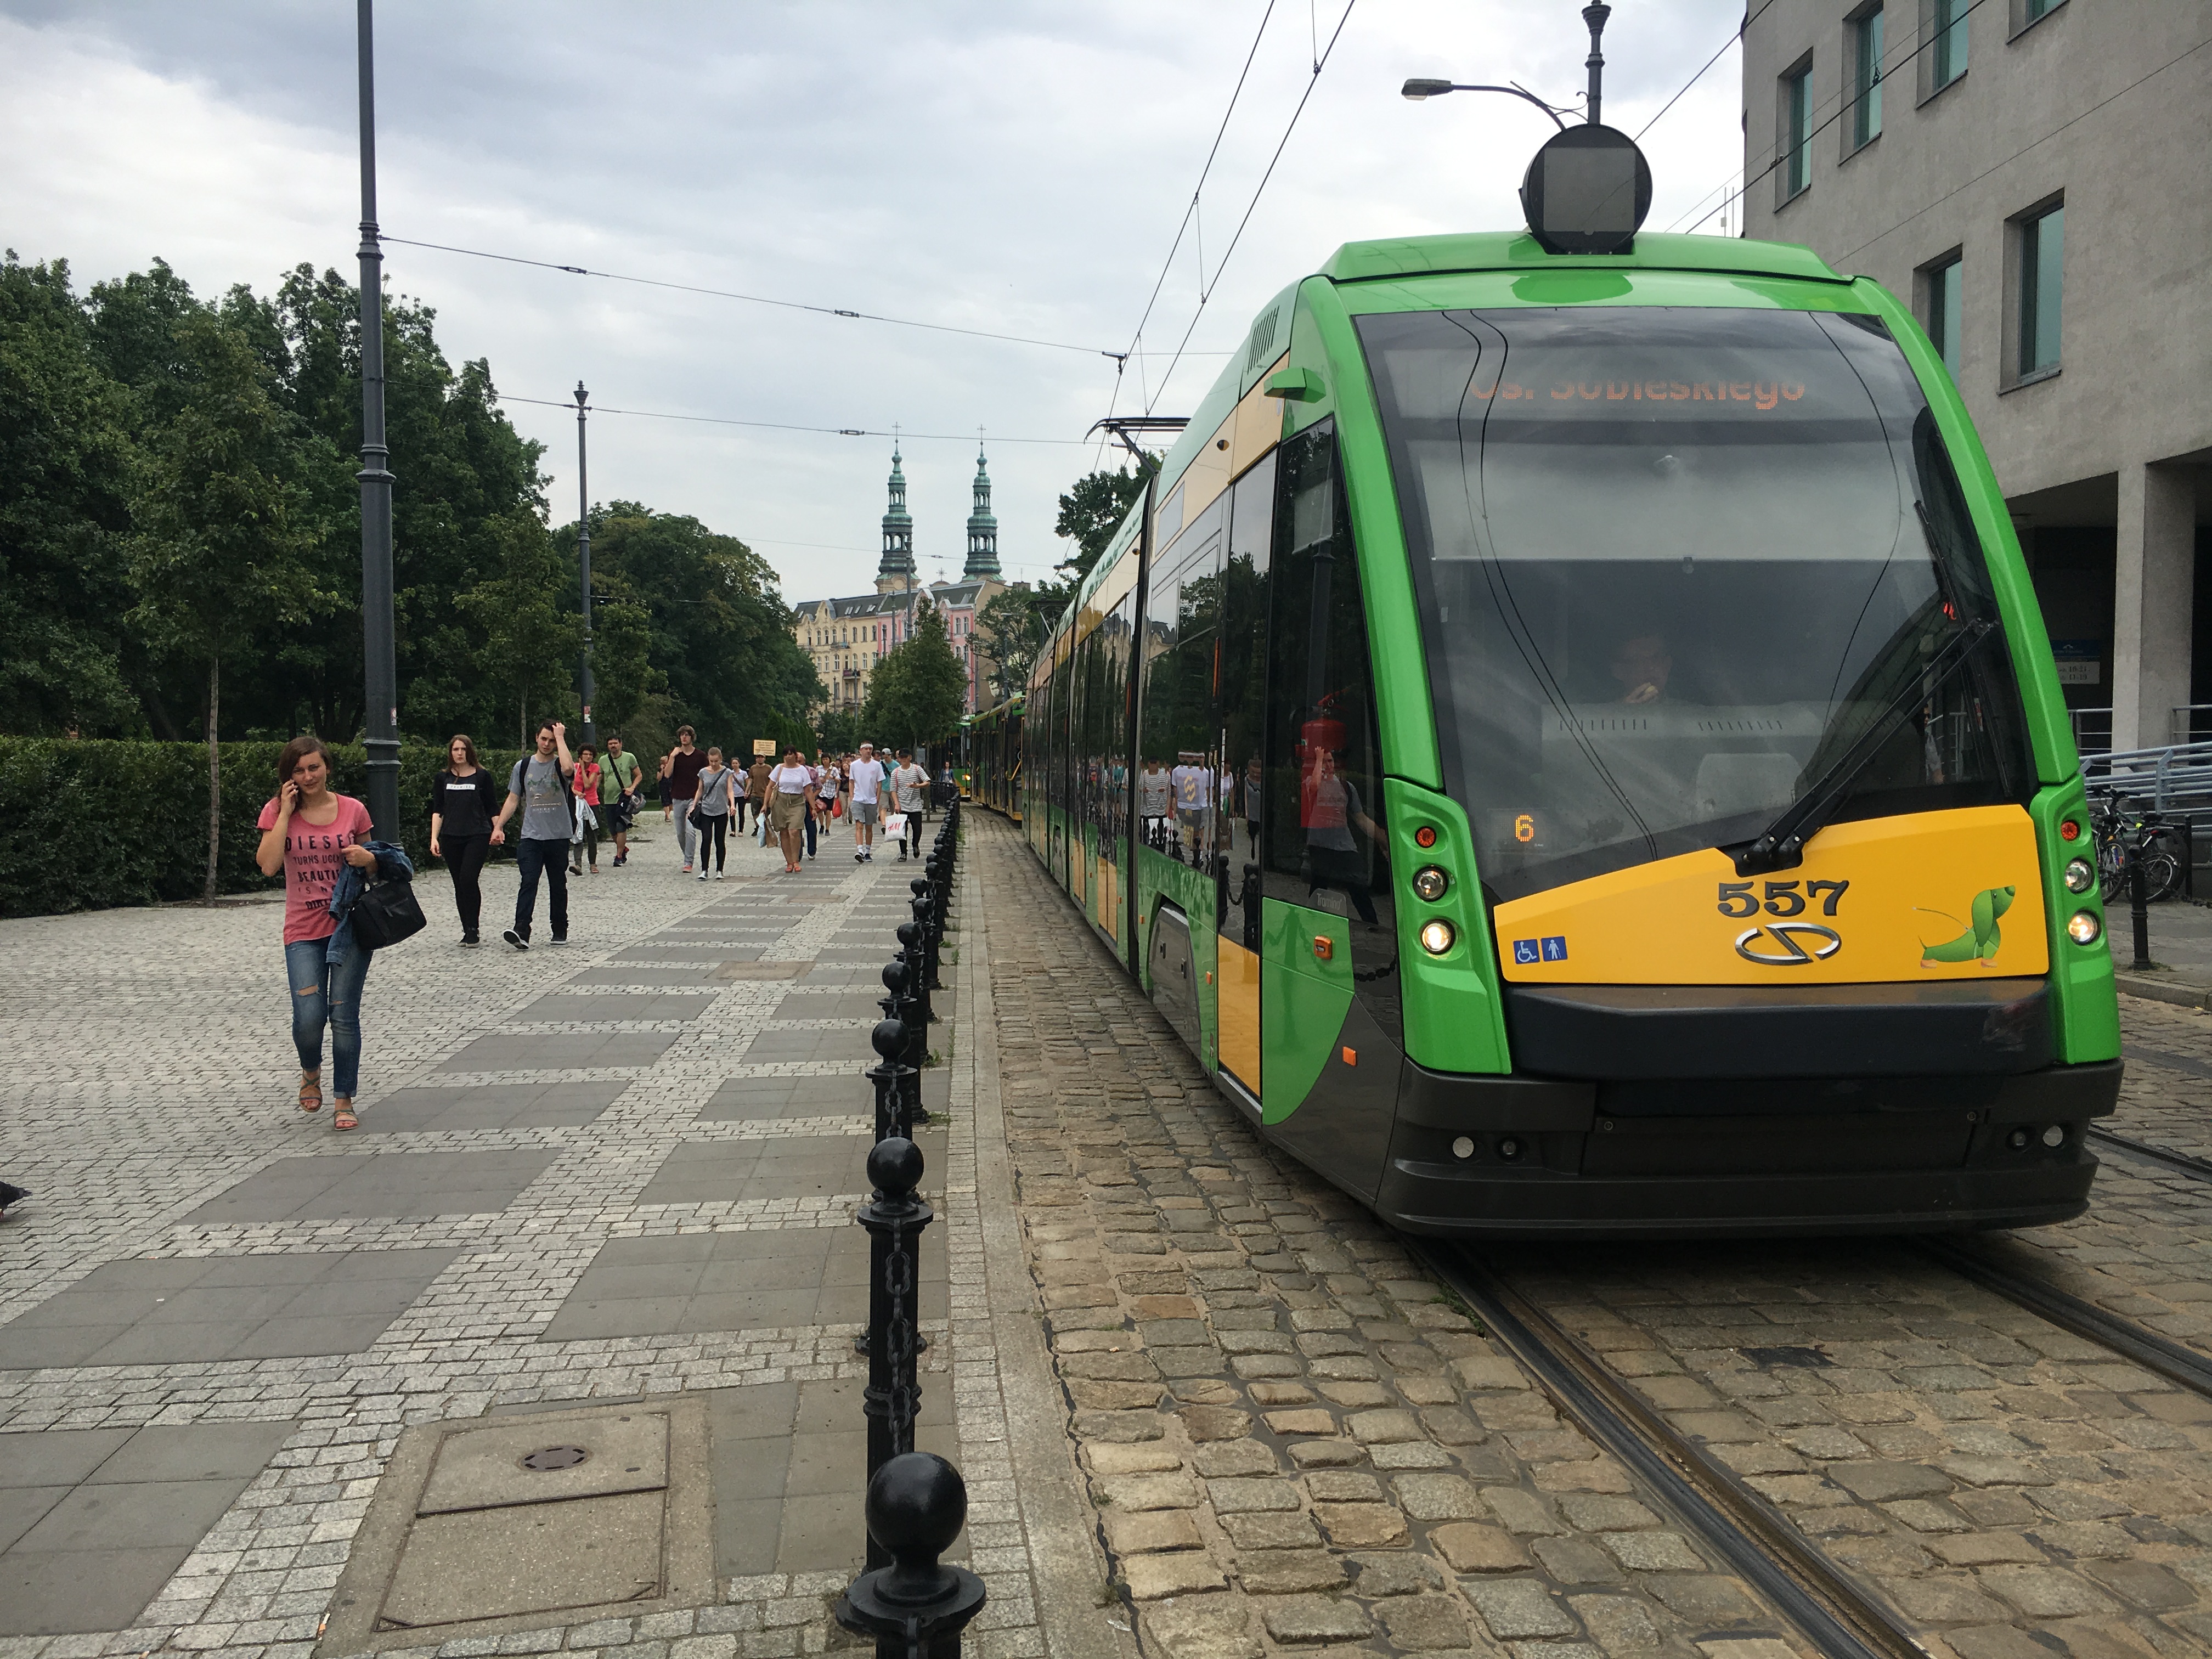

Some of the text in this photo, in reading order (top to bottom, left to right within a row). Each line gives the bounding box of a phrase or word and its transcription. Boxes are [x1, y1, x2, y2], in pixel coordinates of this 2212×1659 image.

[1515, 815, 1534, 842] 6
[294, 854, 340, 865] TURNS UGLY
[305, 898, 332, 910] DIRT
[1718, 880, 1850, 918] 557
